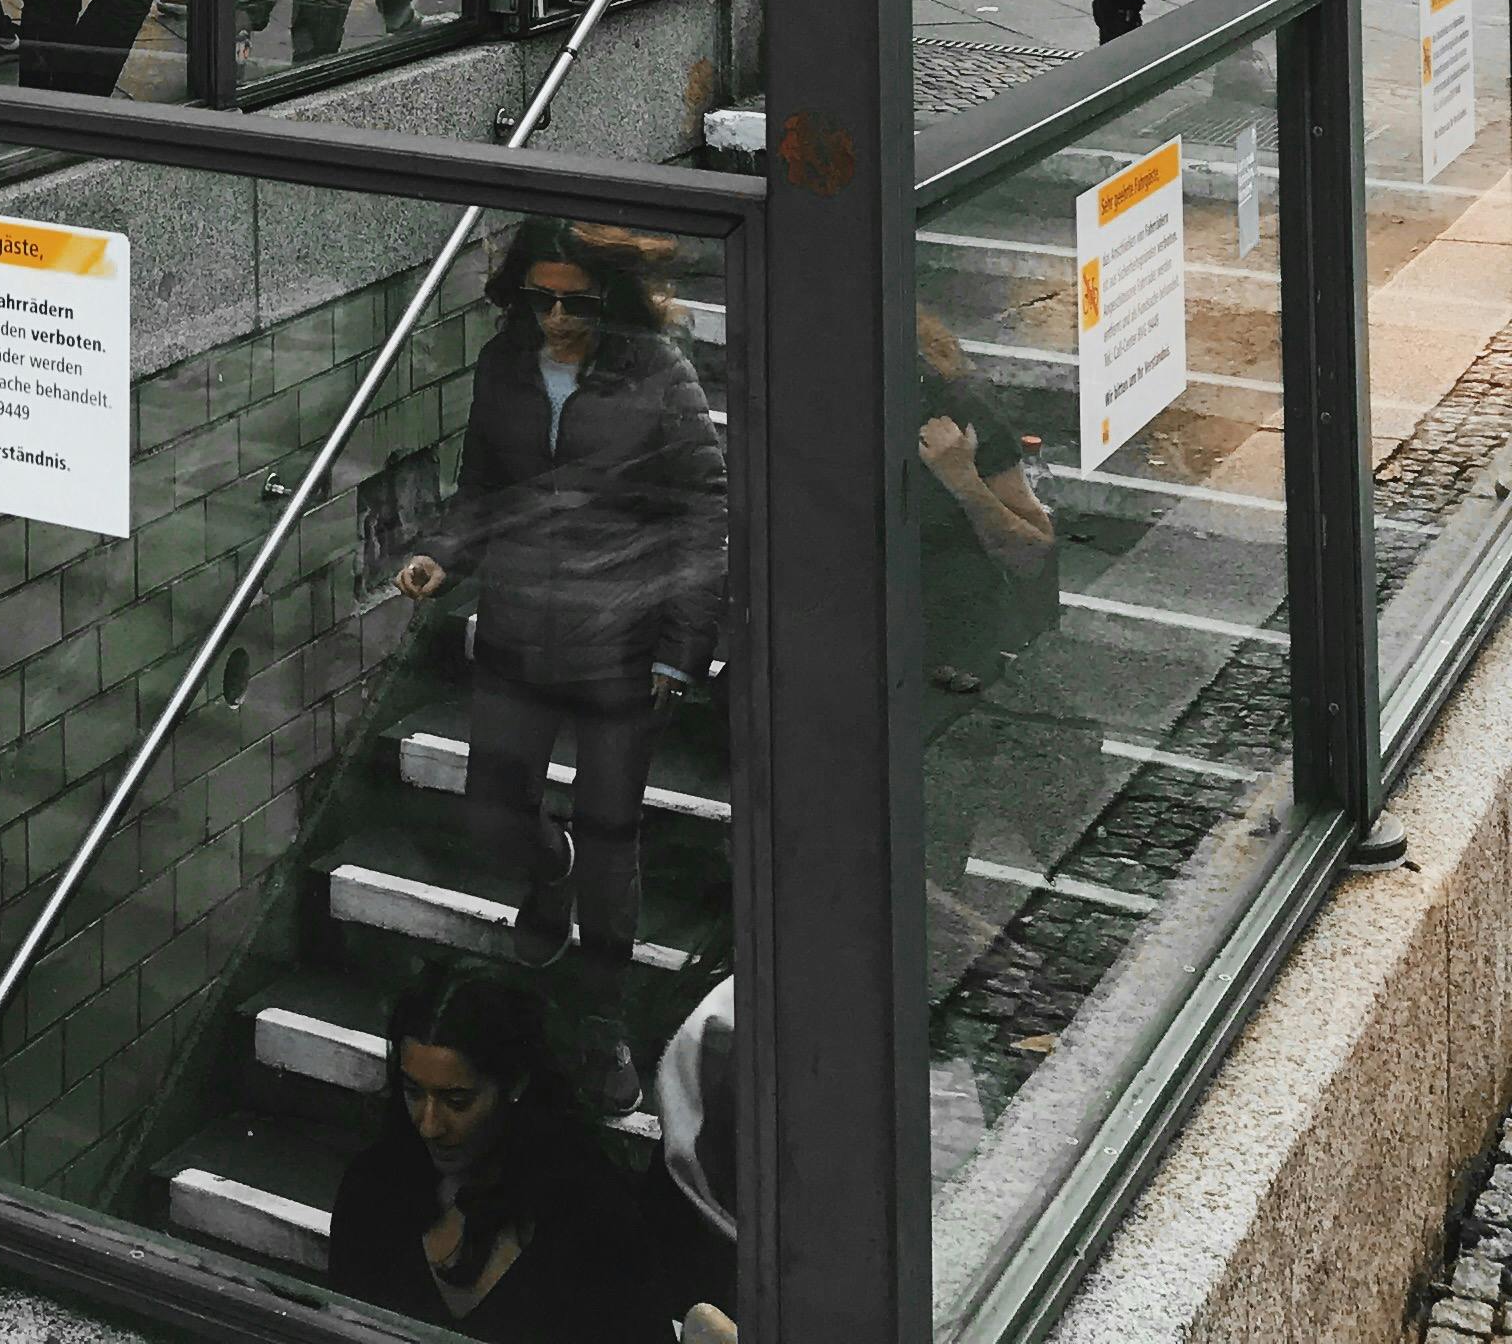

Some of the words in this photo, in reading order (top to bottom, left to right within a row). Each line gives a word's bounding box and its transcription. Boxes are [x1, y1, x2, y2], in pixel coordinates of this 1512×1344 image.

[31, 328, 106, 353] verboten.
[29, 356, 82, 375] werden
[35, 379, 112, 408] behandelt.
